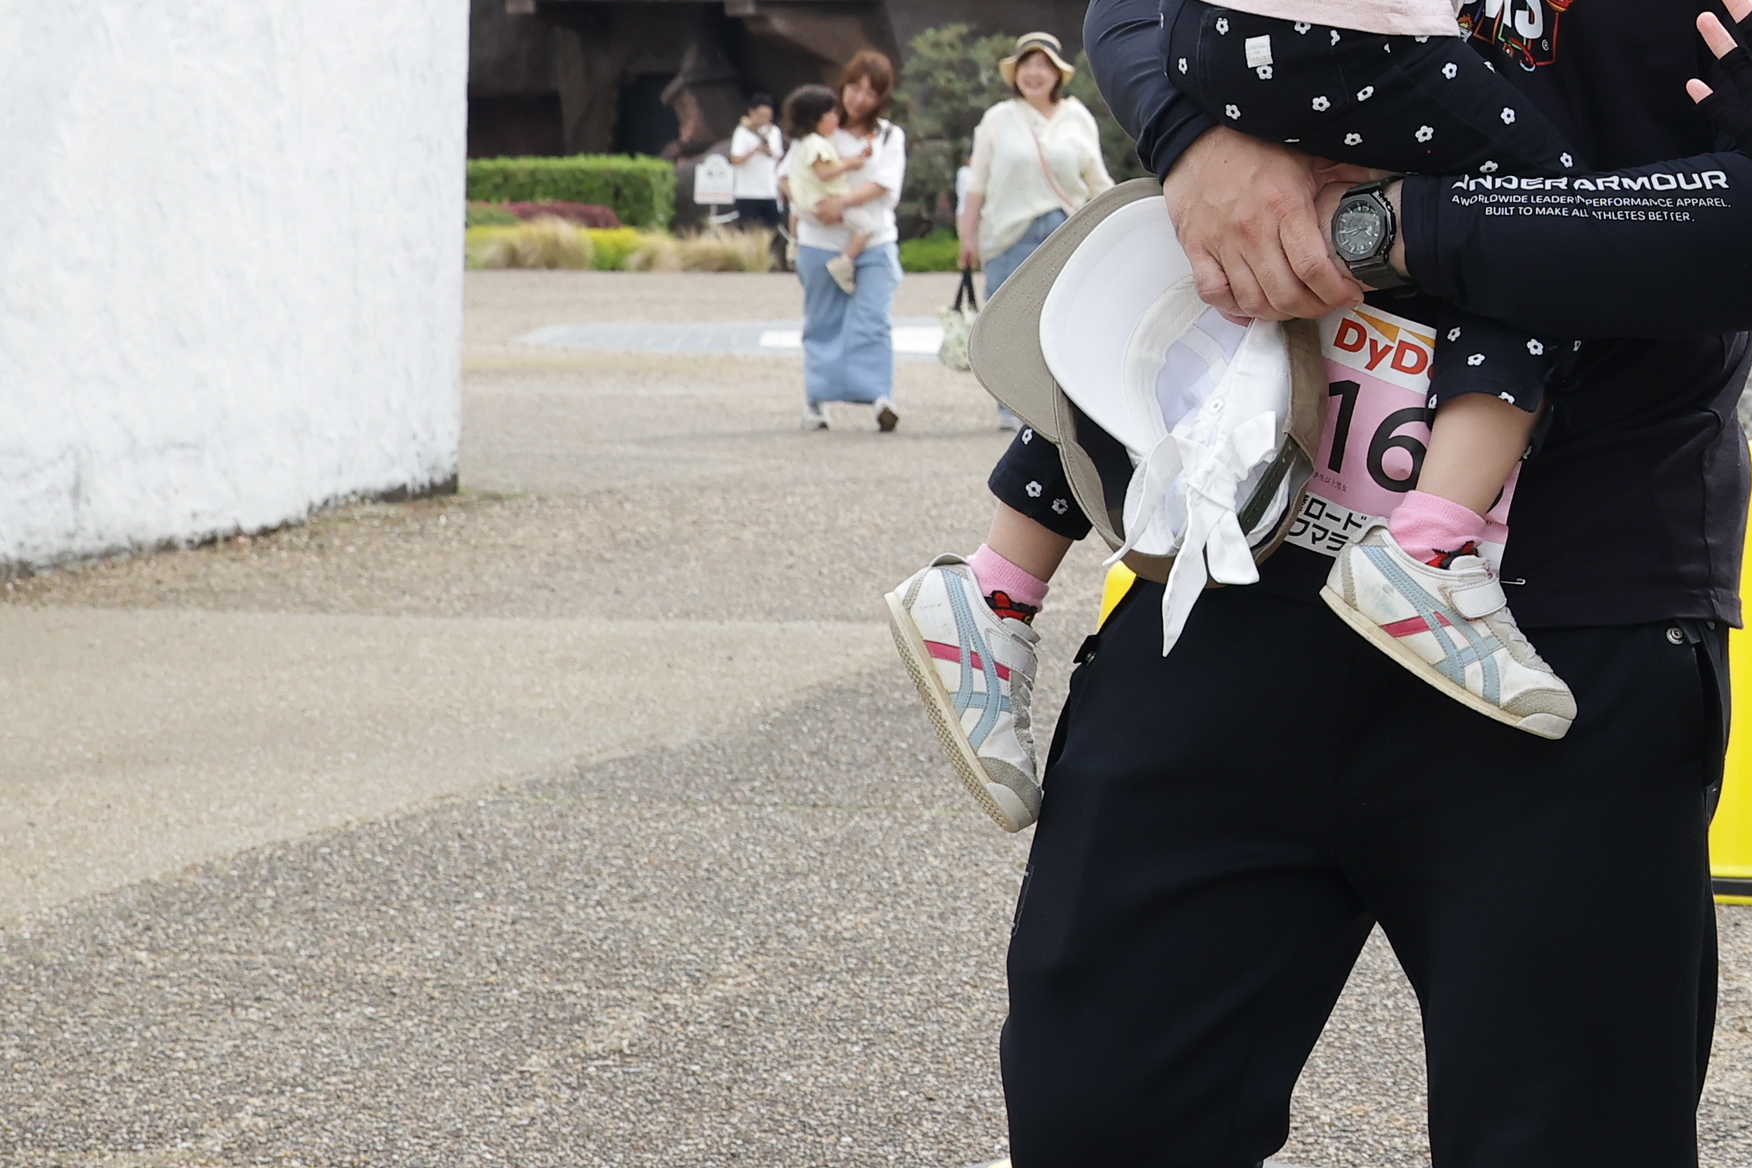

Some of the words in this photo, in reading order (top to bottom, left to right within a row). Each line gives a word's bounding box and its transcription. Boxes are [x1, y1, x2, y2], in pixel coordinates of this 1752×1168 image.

[1573, 170, 1729, 191] ARMOUR
[1452, 194, 1460, 204] A
[1460, 194, 1528, 206] WORLDWIDE
[1531, 195, 1574, 204] LEADER
[1586, 197, 1673, 207] PERFORMANCE
[1676, 197, 1731, 208] APPAREL.
[1485, 206, 1514, 215] BUILT
[1517, 206, 1532, 215] TO
[1535, 207, 1569, 216] MAKE
[1571, 208, 1589, 218] ALL
[1648, 211, 1695, 221] BETTER.
[1333, 317, 1434, 375] DyD
[1328, 379, 1428, 493] 16
